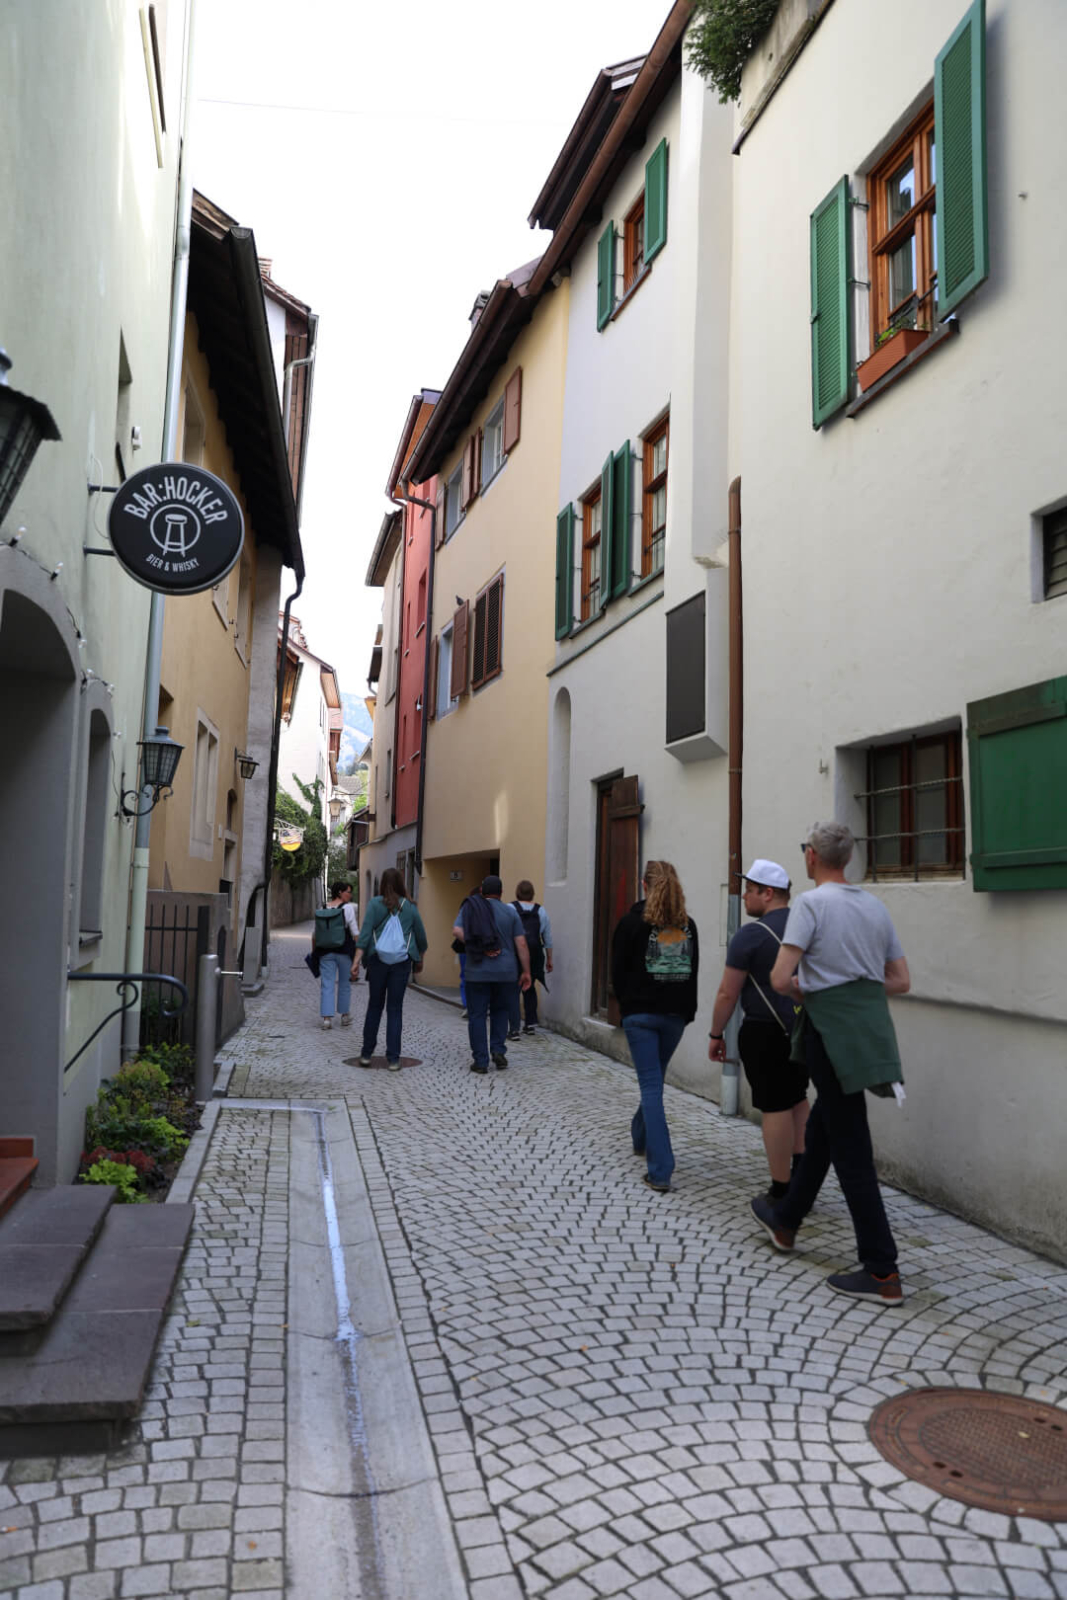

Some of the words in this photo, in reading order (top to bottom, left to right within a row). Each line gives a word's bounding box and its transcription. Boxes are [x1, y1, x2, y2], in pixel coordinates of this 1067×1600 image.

[146, 553, 163, 569] BIER
[164, 561, 170, 571] &
[172, 557, 199, 572] WHISKY
